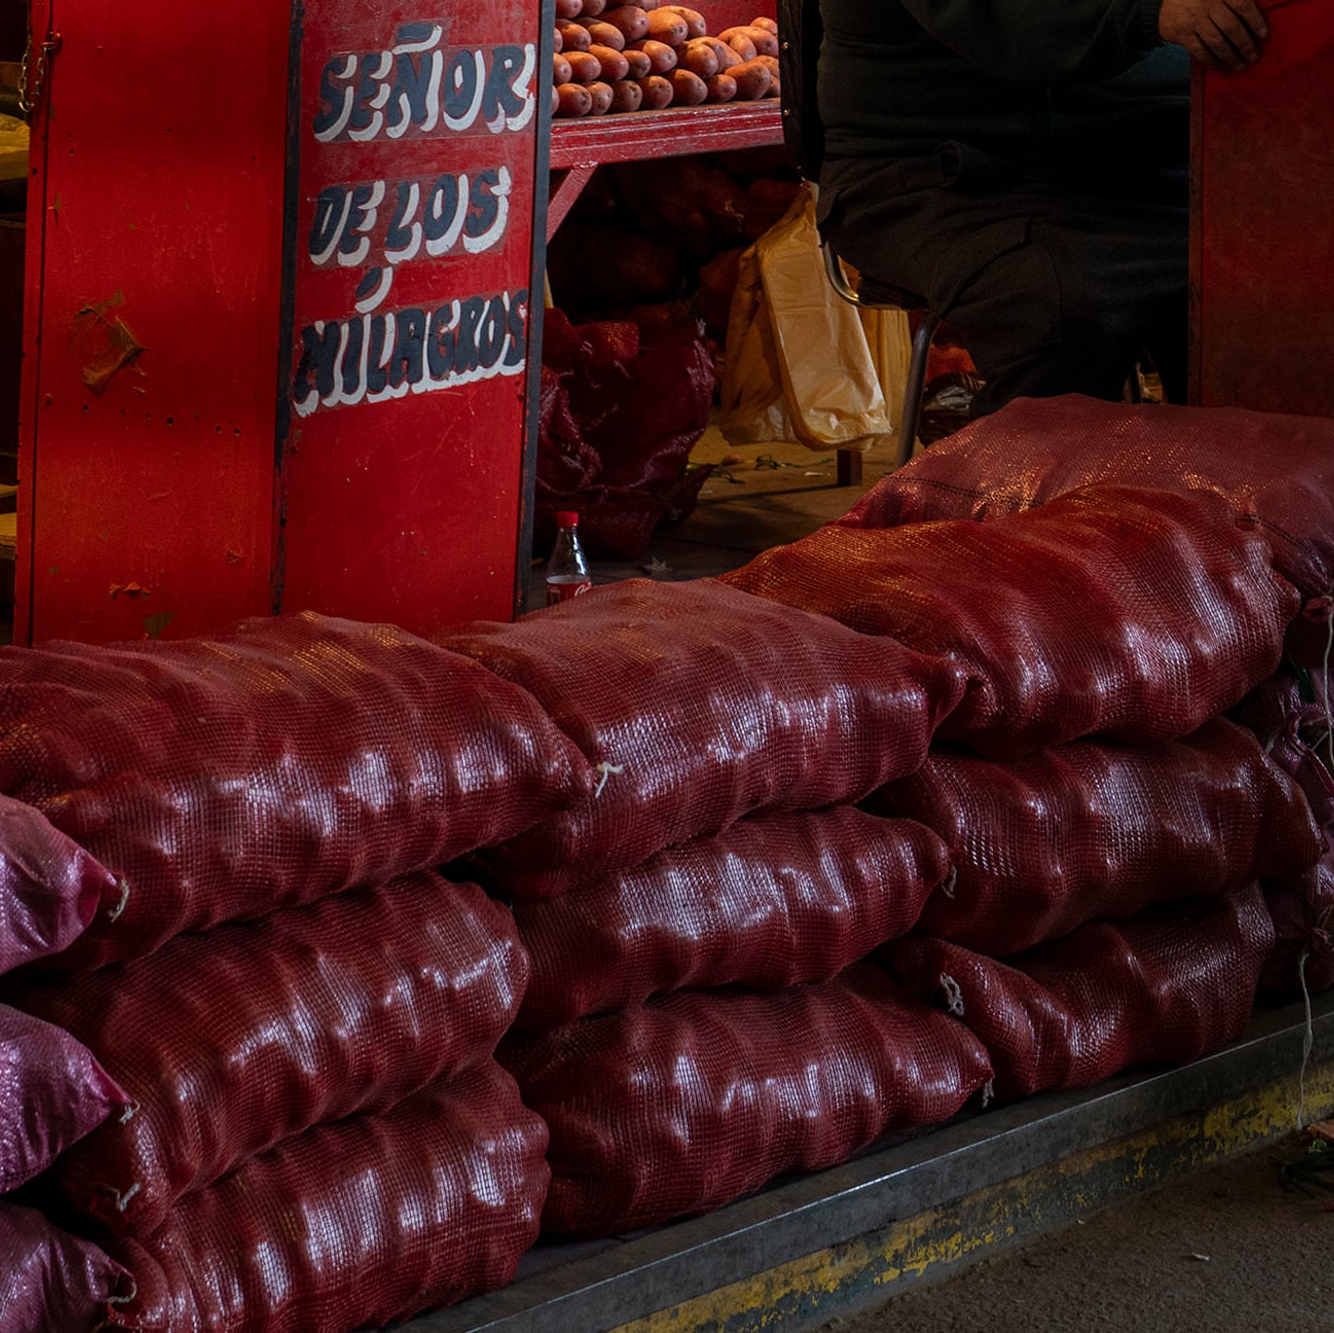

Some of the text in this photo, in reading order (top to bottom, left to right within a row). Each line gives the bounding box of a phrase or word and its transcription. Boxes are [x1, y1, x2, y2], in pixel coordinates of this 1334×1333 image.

[313, 21, 536, 142] SEÑOR
[309, 165, 512, 266] DE LOS
